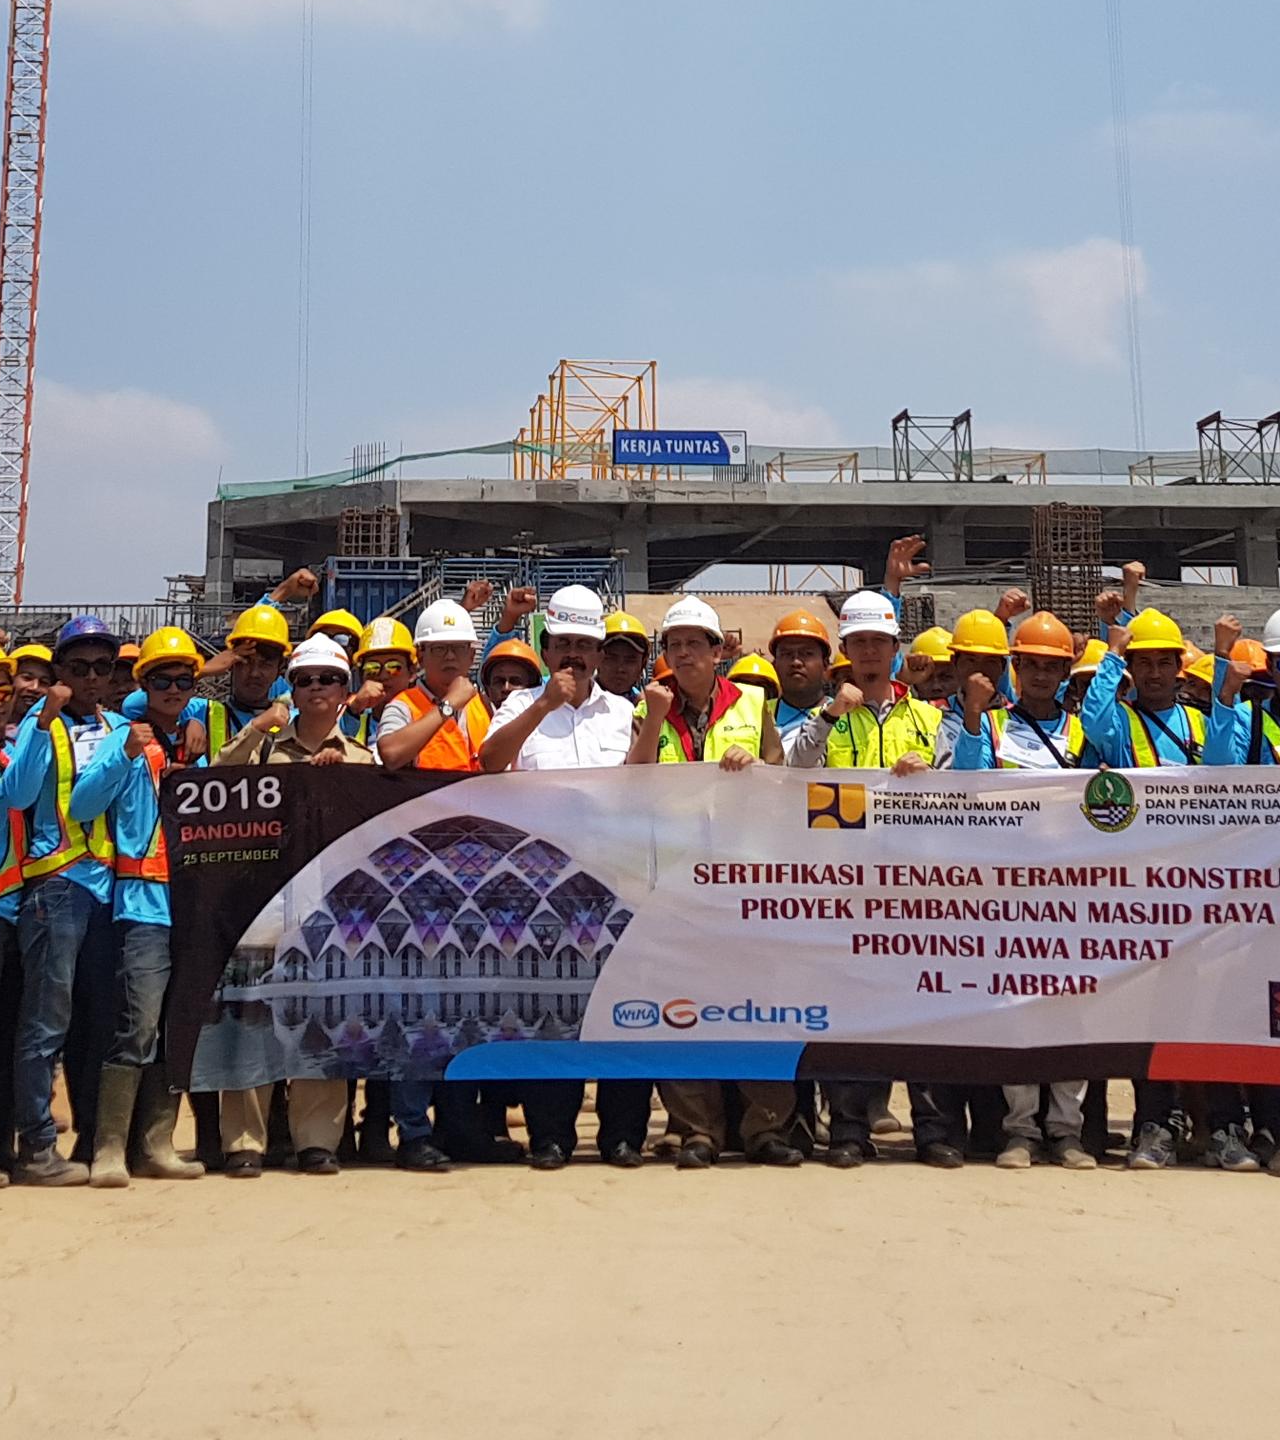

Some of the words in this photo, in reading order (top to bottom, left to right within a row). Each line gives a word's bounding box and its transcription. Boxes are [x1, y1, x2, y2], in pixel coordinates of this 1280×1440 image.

[620, 439, 662, 456] KERJA
[665, 439, 720, 454] TUNTAS
[176, 776, 282, 814] 2018
[1145, 785, 1189, 795] DINAS
[1194, 784, 1228, 794] BINA
[873, 799, 959, 811] PEKERJAAN
[963, 801, 1007, 811] UMUM
[1010, 801, 1040, 811] DAN
[1145, 799, 1176, 809] DAN
[1180, 799, 1246, 810] PENATAN
[873, 814, 964, 826] PERUMAHAN
[968, 815, 1024, 827] RAKYAT
[1146, 814, 1215, 825] PROVINSI
[1219, 815, 1260, 825] JAWA
[181, 821, 282, 842] BANDUNG
[183, 853, 198, 865] 25
[200, 849, 279, 863] SEPTEMBER
[693, 863, 864, 886] SERTIFIKASI
[873, 865, 983, 886] TENAGA
[992, 866, 1136, 888] TERAMPIL
[741, 898, 854, 920] PROYEK
[864, 899, 1076, 923] PEMBANGUNAN
[1087, 901, 1193, 925] MASJID
[1203, 902, 1276, 925] RAYA
[852, 933, 985, 958] PROVINSI
[994, 936, 1070, 959] JAWA
[1080, 938, 1174, 961] BARAT
[916, 971, 952, 993] AL
[987, 973, 1098, 996] JABBAR
[615, 1005, 658, 1023] WIKA
[662, 999, 830, 1030] Gedung
